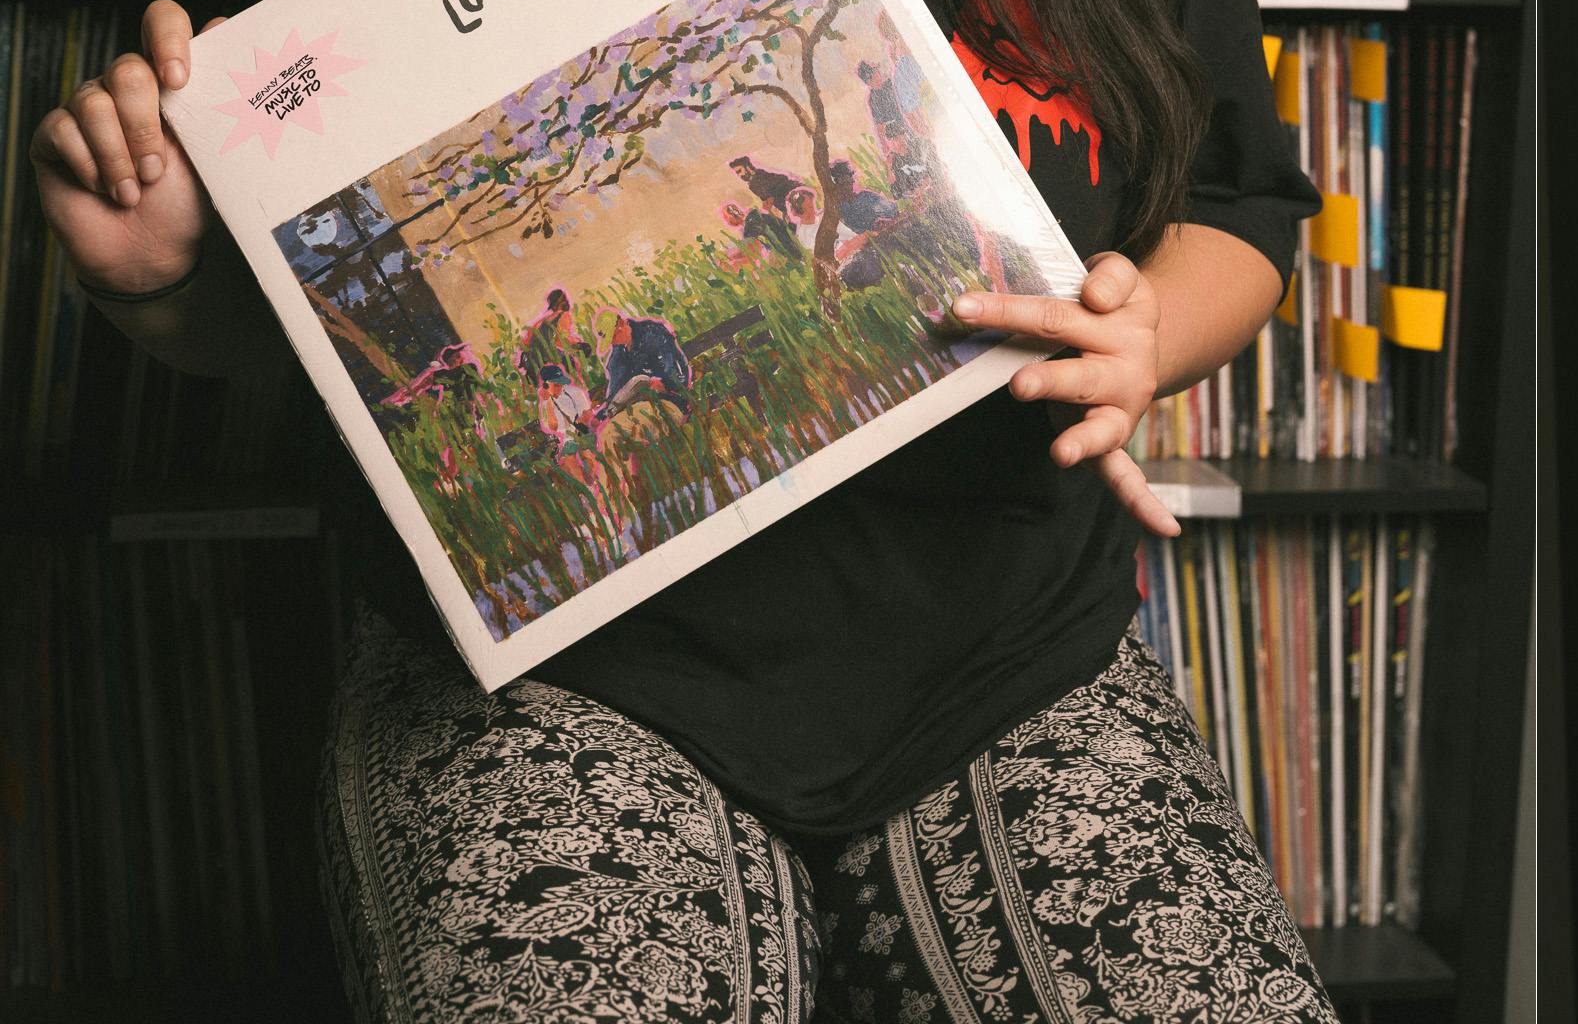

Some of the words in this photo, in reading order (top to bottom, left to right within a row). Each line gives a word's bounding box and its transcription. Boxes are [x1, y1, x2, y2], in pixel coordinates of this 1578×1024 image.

[248, 77, 278, 106] KENNY
[264, 81, 301, 115] MUSIC
[298, 69, 316, 84] TO
[275, 91, 304, 121] LIVE
[302, 79, 320, 97] TO
